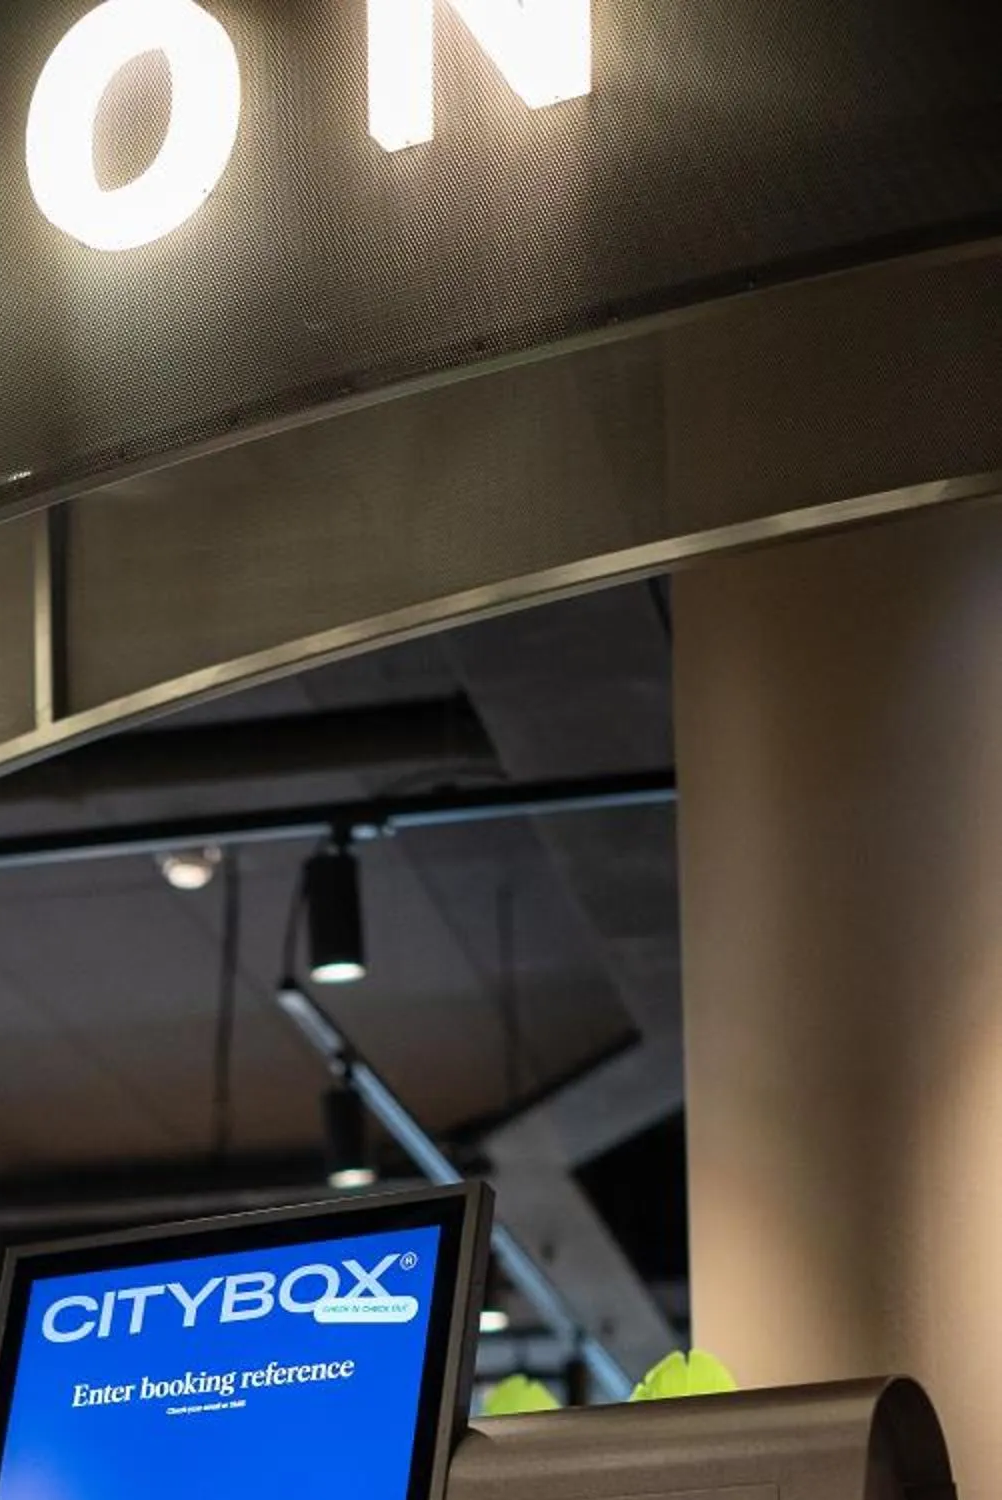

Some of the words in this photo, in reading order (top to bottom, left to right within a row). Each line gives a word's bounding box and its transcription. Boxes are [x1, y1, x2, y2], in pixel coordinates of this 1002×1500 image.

[72, 1383, 136, 1408] Enter
[140, 1371, 236, 1402] booking
[240, 1359, 355, 1389] reference
